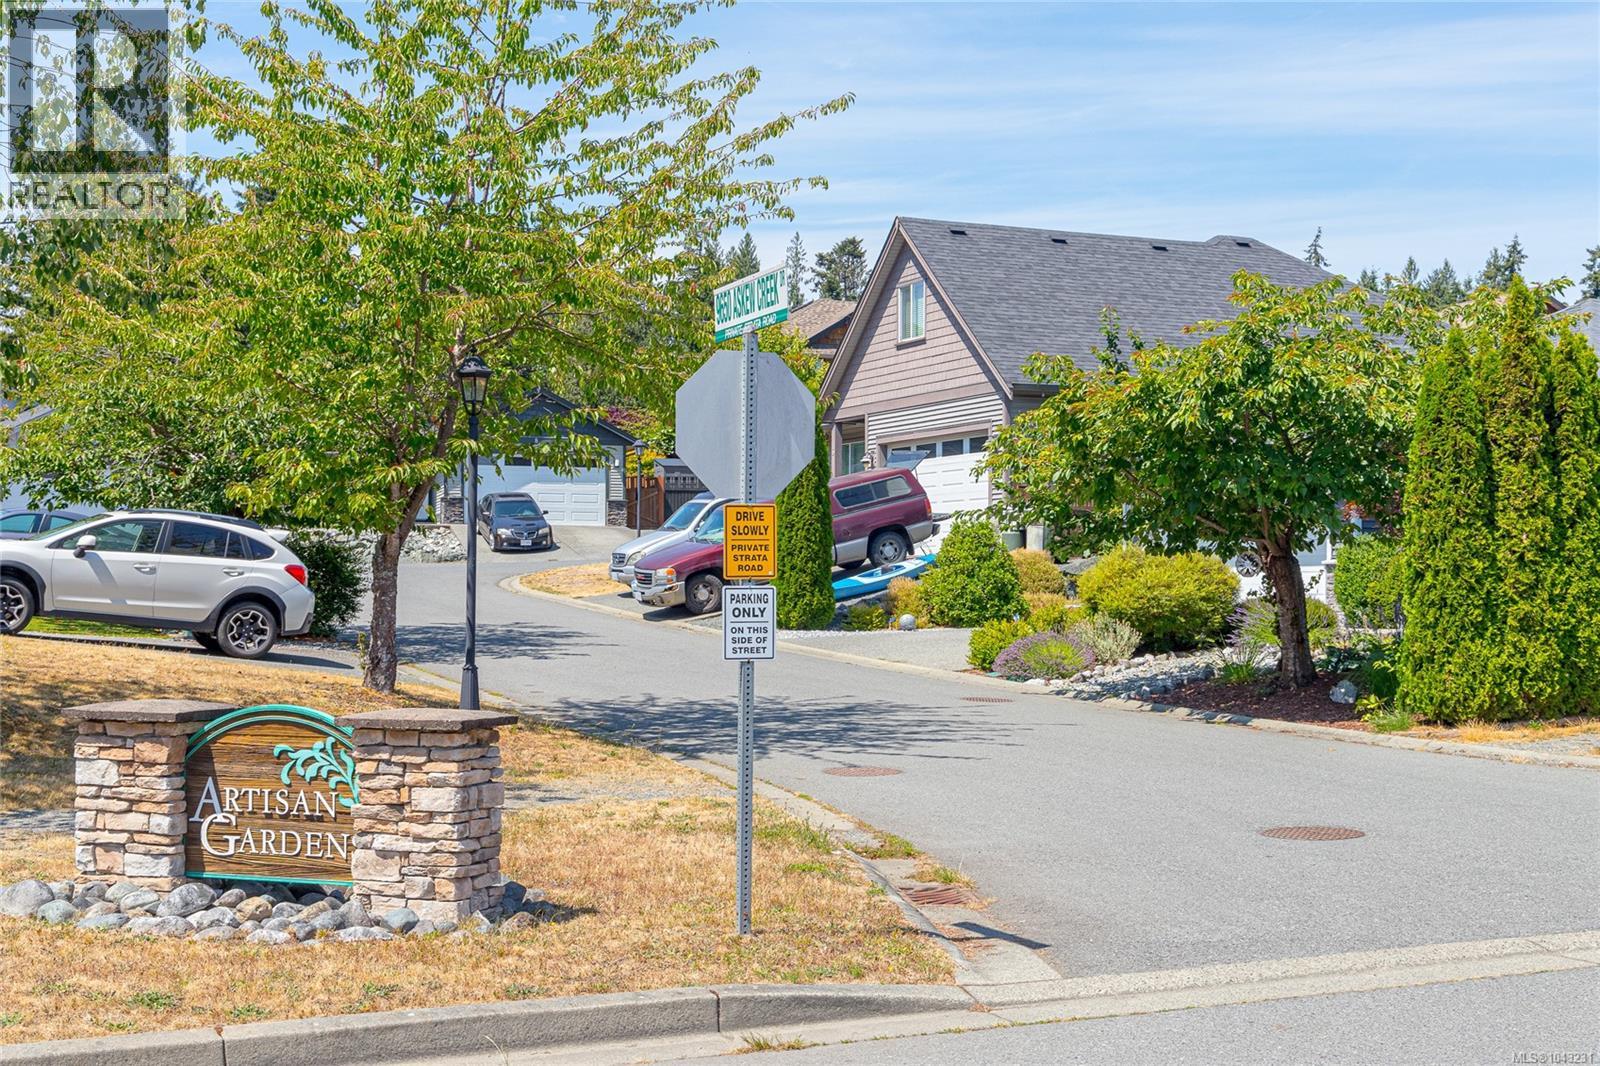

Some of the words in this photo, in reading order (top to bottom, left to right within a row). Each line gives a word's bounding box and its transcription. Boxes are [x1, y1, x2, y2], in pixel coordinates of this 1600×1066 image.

[733, 280, 756, 319] ASKEW
[757, 272, 779, 311] CREEK
[736, 511, 765, 521] DRIVE
[731, 525, 769, 536] SLOWLY
[731, 544, 769, 552] PRIVATE
[730, 593, 769, 604] PARKING
[732, 607, 767, 618] ONLY
[730, 626, 744, 634] ON
[747, 626, 768, 634] THIS
[756, 636, 768, 644] OF
[732, 646, 767, 654] STREET
[189, 776, 338, 823] ARTISAN
[200, 812, 354, 863] GARDEN
